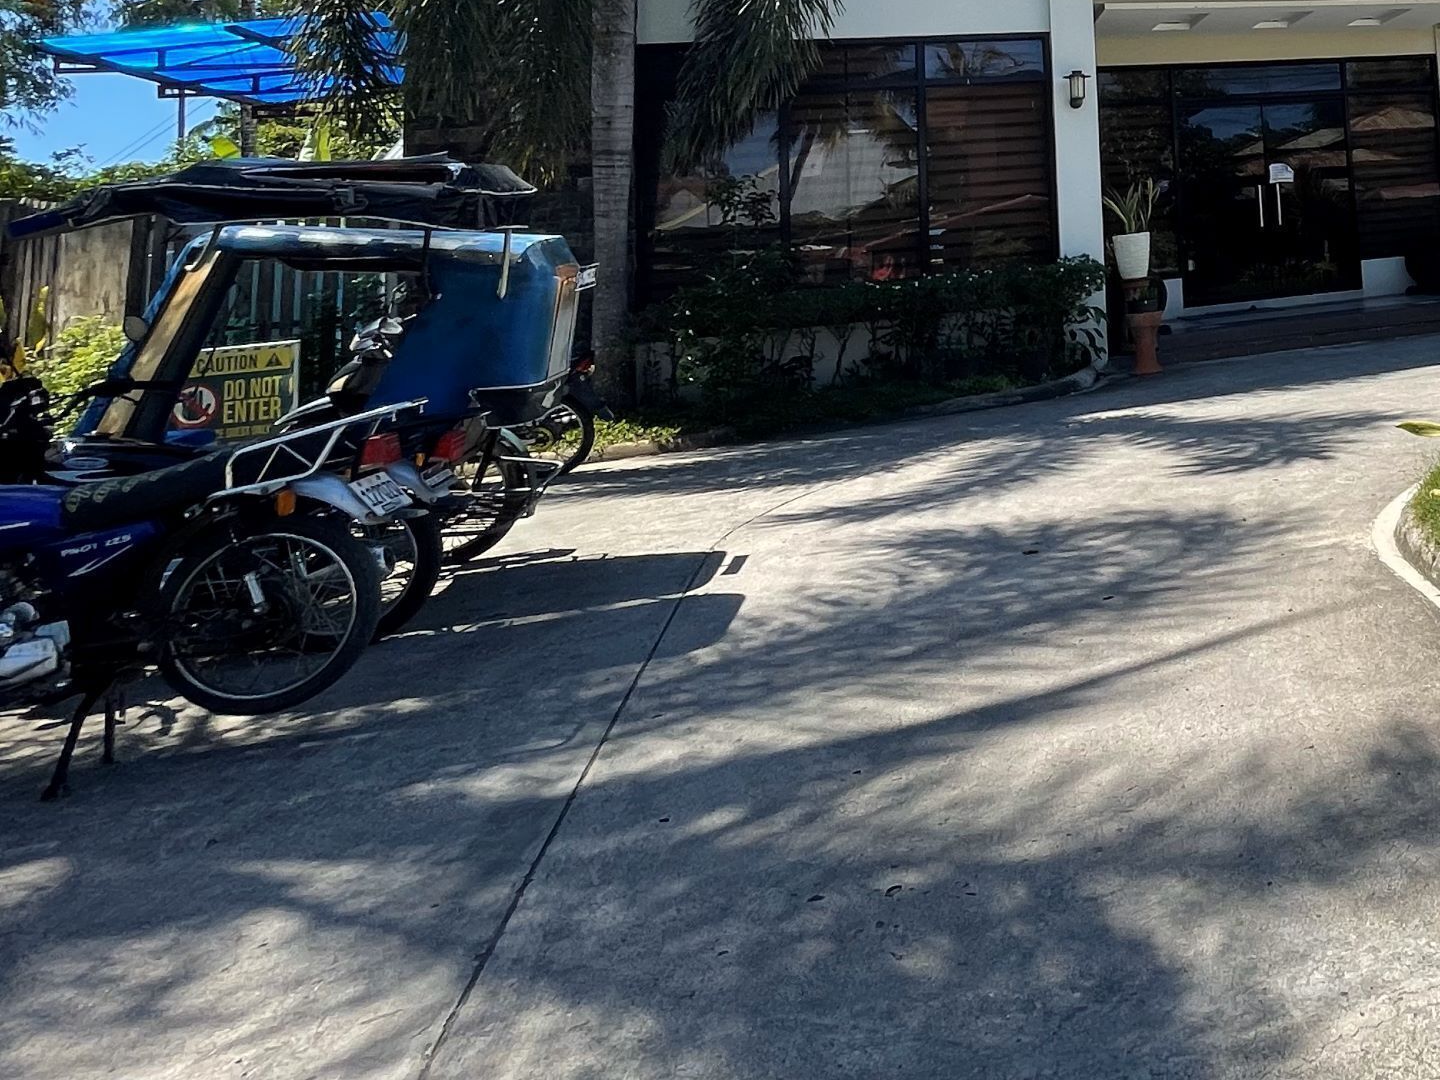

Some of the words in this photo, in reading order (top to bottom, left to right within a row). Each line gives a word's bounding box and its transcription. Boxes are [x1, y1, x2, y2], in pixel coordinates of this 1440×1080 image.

[196, 354, 258, 374] CAUTION
[223, 378, 246, 401] DO
[250, 374, 283, 398] NOT
[223, 396, 282, 424] ENTER
